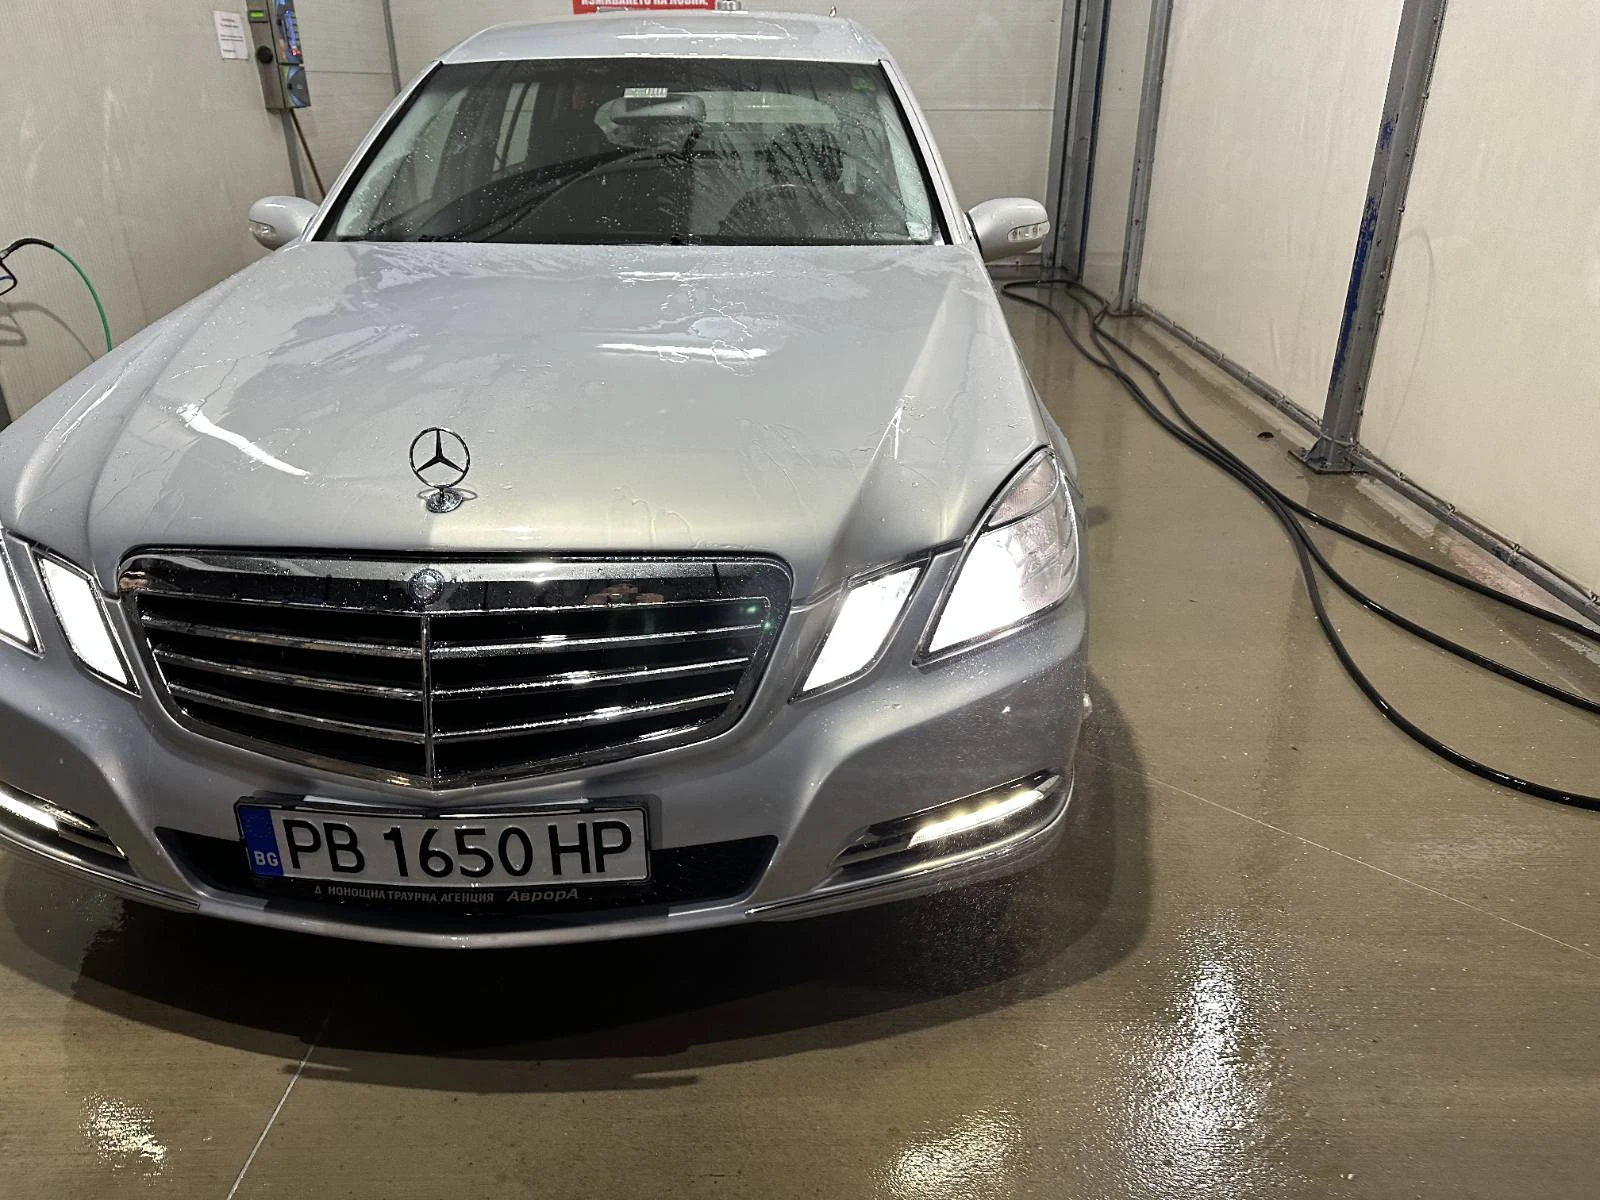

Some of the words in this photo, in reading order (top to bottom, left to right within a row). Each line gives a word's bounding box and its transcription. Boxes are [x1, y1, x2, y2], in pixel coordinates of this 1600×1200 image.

[282, 819, 366, 874] PB
[383, 826, 534, 878] 1650
[548, 821, 632, 875] HP
[253, 850, 279, 867] BG
[387, 890, 437, 902] ТРАУРНА
[440, 892, 495, 904] АГЕНЦИЯ
